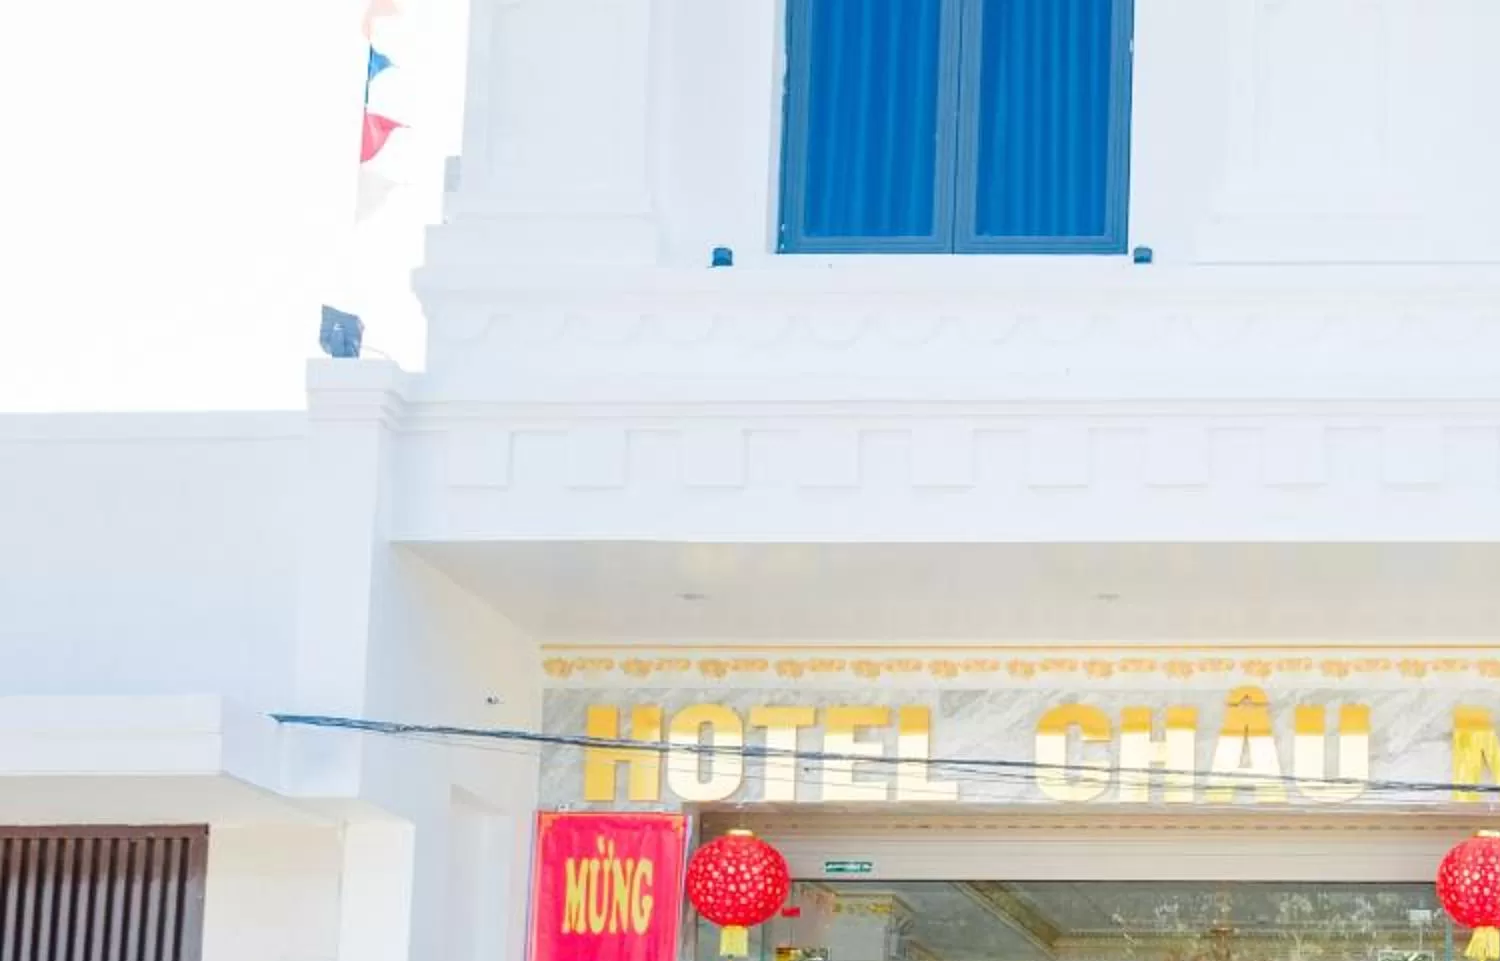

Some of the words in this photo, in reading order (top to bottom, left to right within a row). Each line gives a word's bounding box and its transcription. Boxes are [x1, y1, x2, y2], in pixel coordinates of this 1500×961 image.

[584, 703, 958, 802] HOTEL
[1035, 685, 1371, 802] CHÂU
[561, 835, 653, 934] MỪNG
